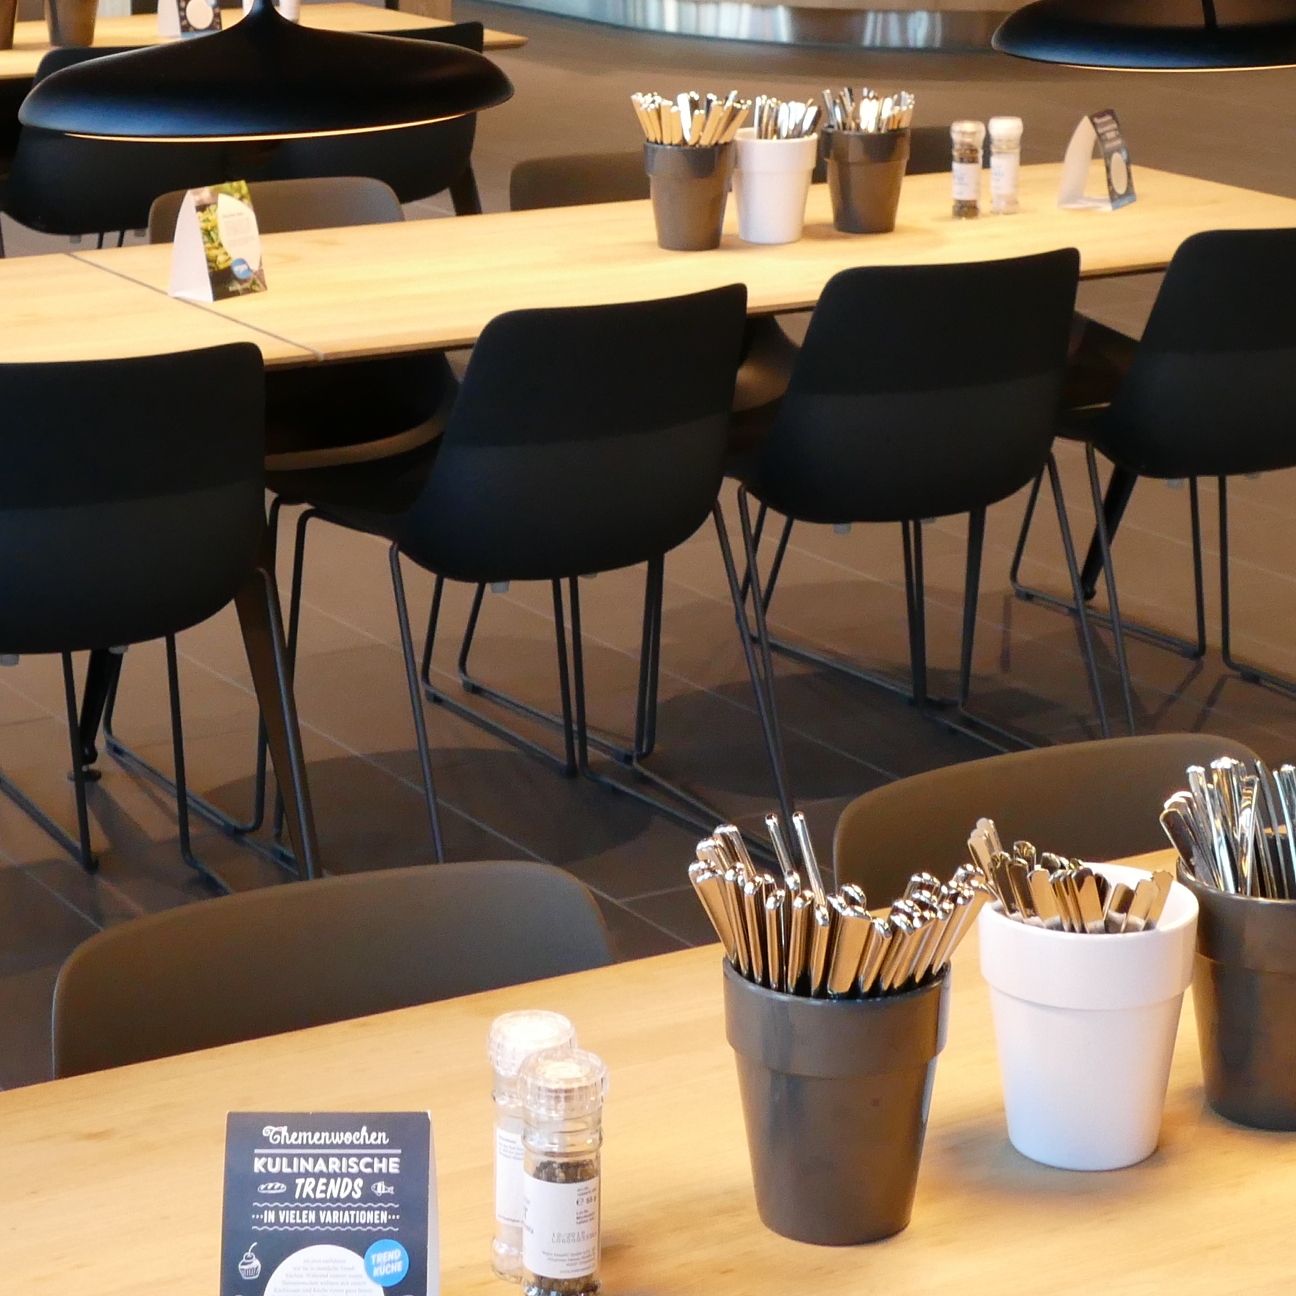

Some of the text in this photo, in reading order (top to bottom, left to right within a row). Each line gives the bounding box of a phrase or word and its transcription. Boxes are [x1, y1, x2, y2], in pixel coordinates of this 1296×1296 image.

[262, 1125, 389, 1145] Themenwochen
[254, 1156, 401, 1174] KULINARISCHE
[294, 1177, 364, 1200] TRENDS
[263, 1209, 388, 1224] IN VIELEN VARIATIONEN
[371, 1248, 402, 1265] TREND
